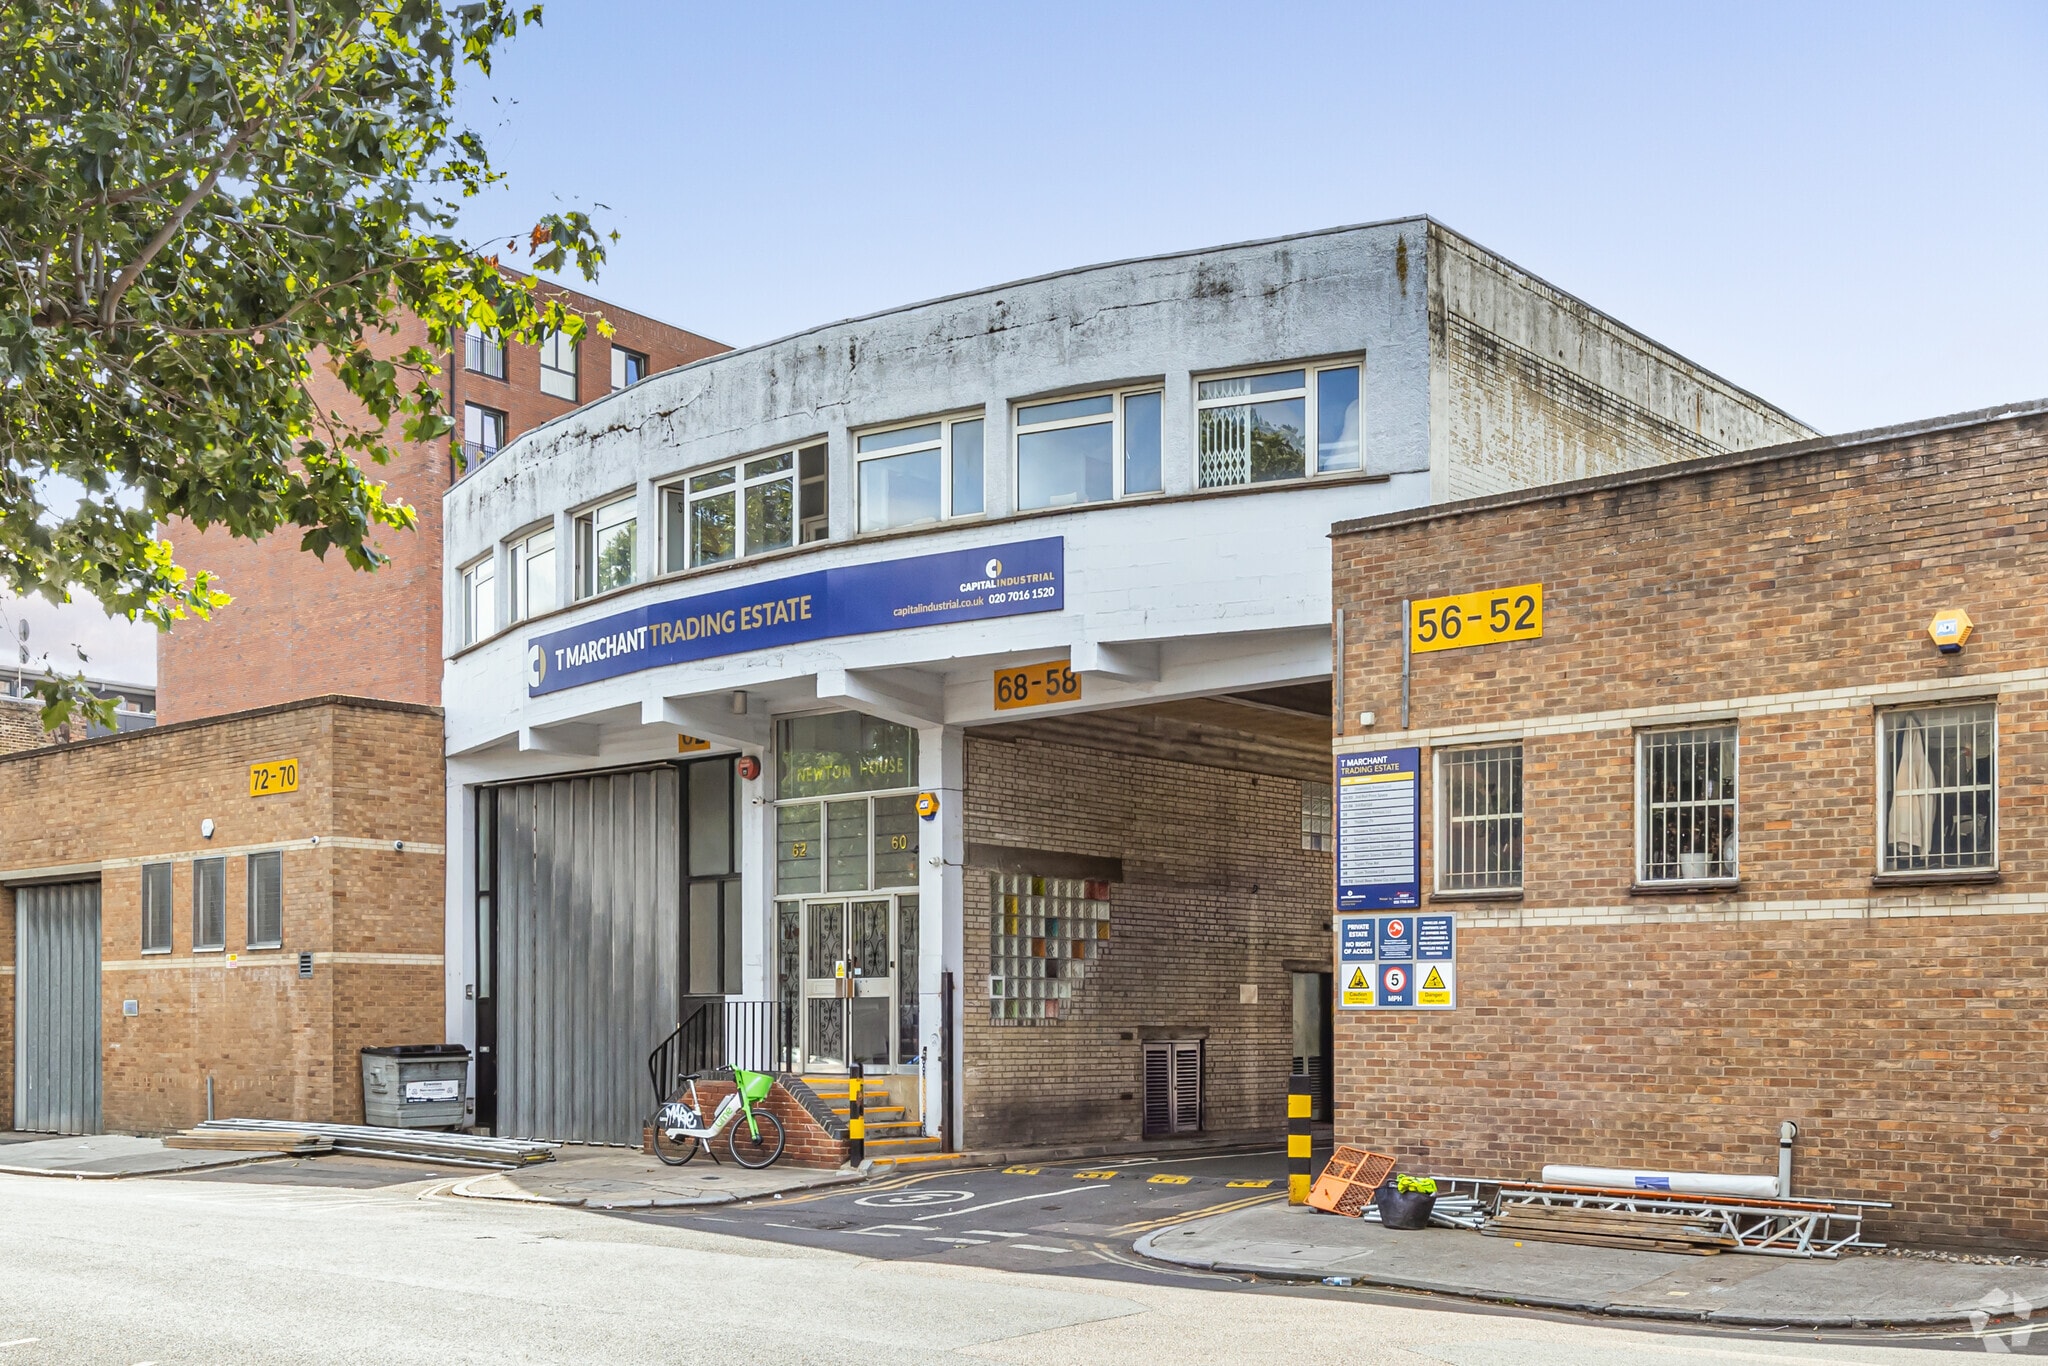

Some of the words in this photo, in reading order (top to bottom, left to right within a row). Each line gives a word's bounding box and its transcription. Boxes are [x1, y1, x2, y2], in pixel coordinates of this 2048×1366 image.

[893, 596, 984, 617] capitalindustrial.co.uk
[988, 593, 1006, 605] 020
[1007, 589, 1030, 602] 7016
[1031, 586, 1055, 599] 1520
[555, 649, 565, 671] T
[566, 626, 648, 669] MARCHANT
[649, 609, 736, 647] TRADING
[740, 594, 812, 630] ESTATE
[797, 765, 852, 782] NEWTON
[860, 757, 904, 776] HOUSE
[1341, 759, 1346, 767] T
[1346, 756, 1388, 767] MARCHANT
[1341, 766, 1373, 775] TRADING
[1374, 763, 1400, 772] ESTATE
[792, 841, 807, 857] 62
[891, 834, 907, 850] 60
[1391, 973, 1400, 986] 5
